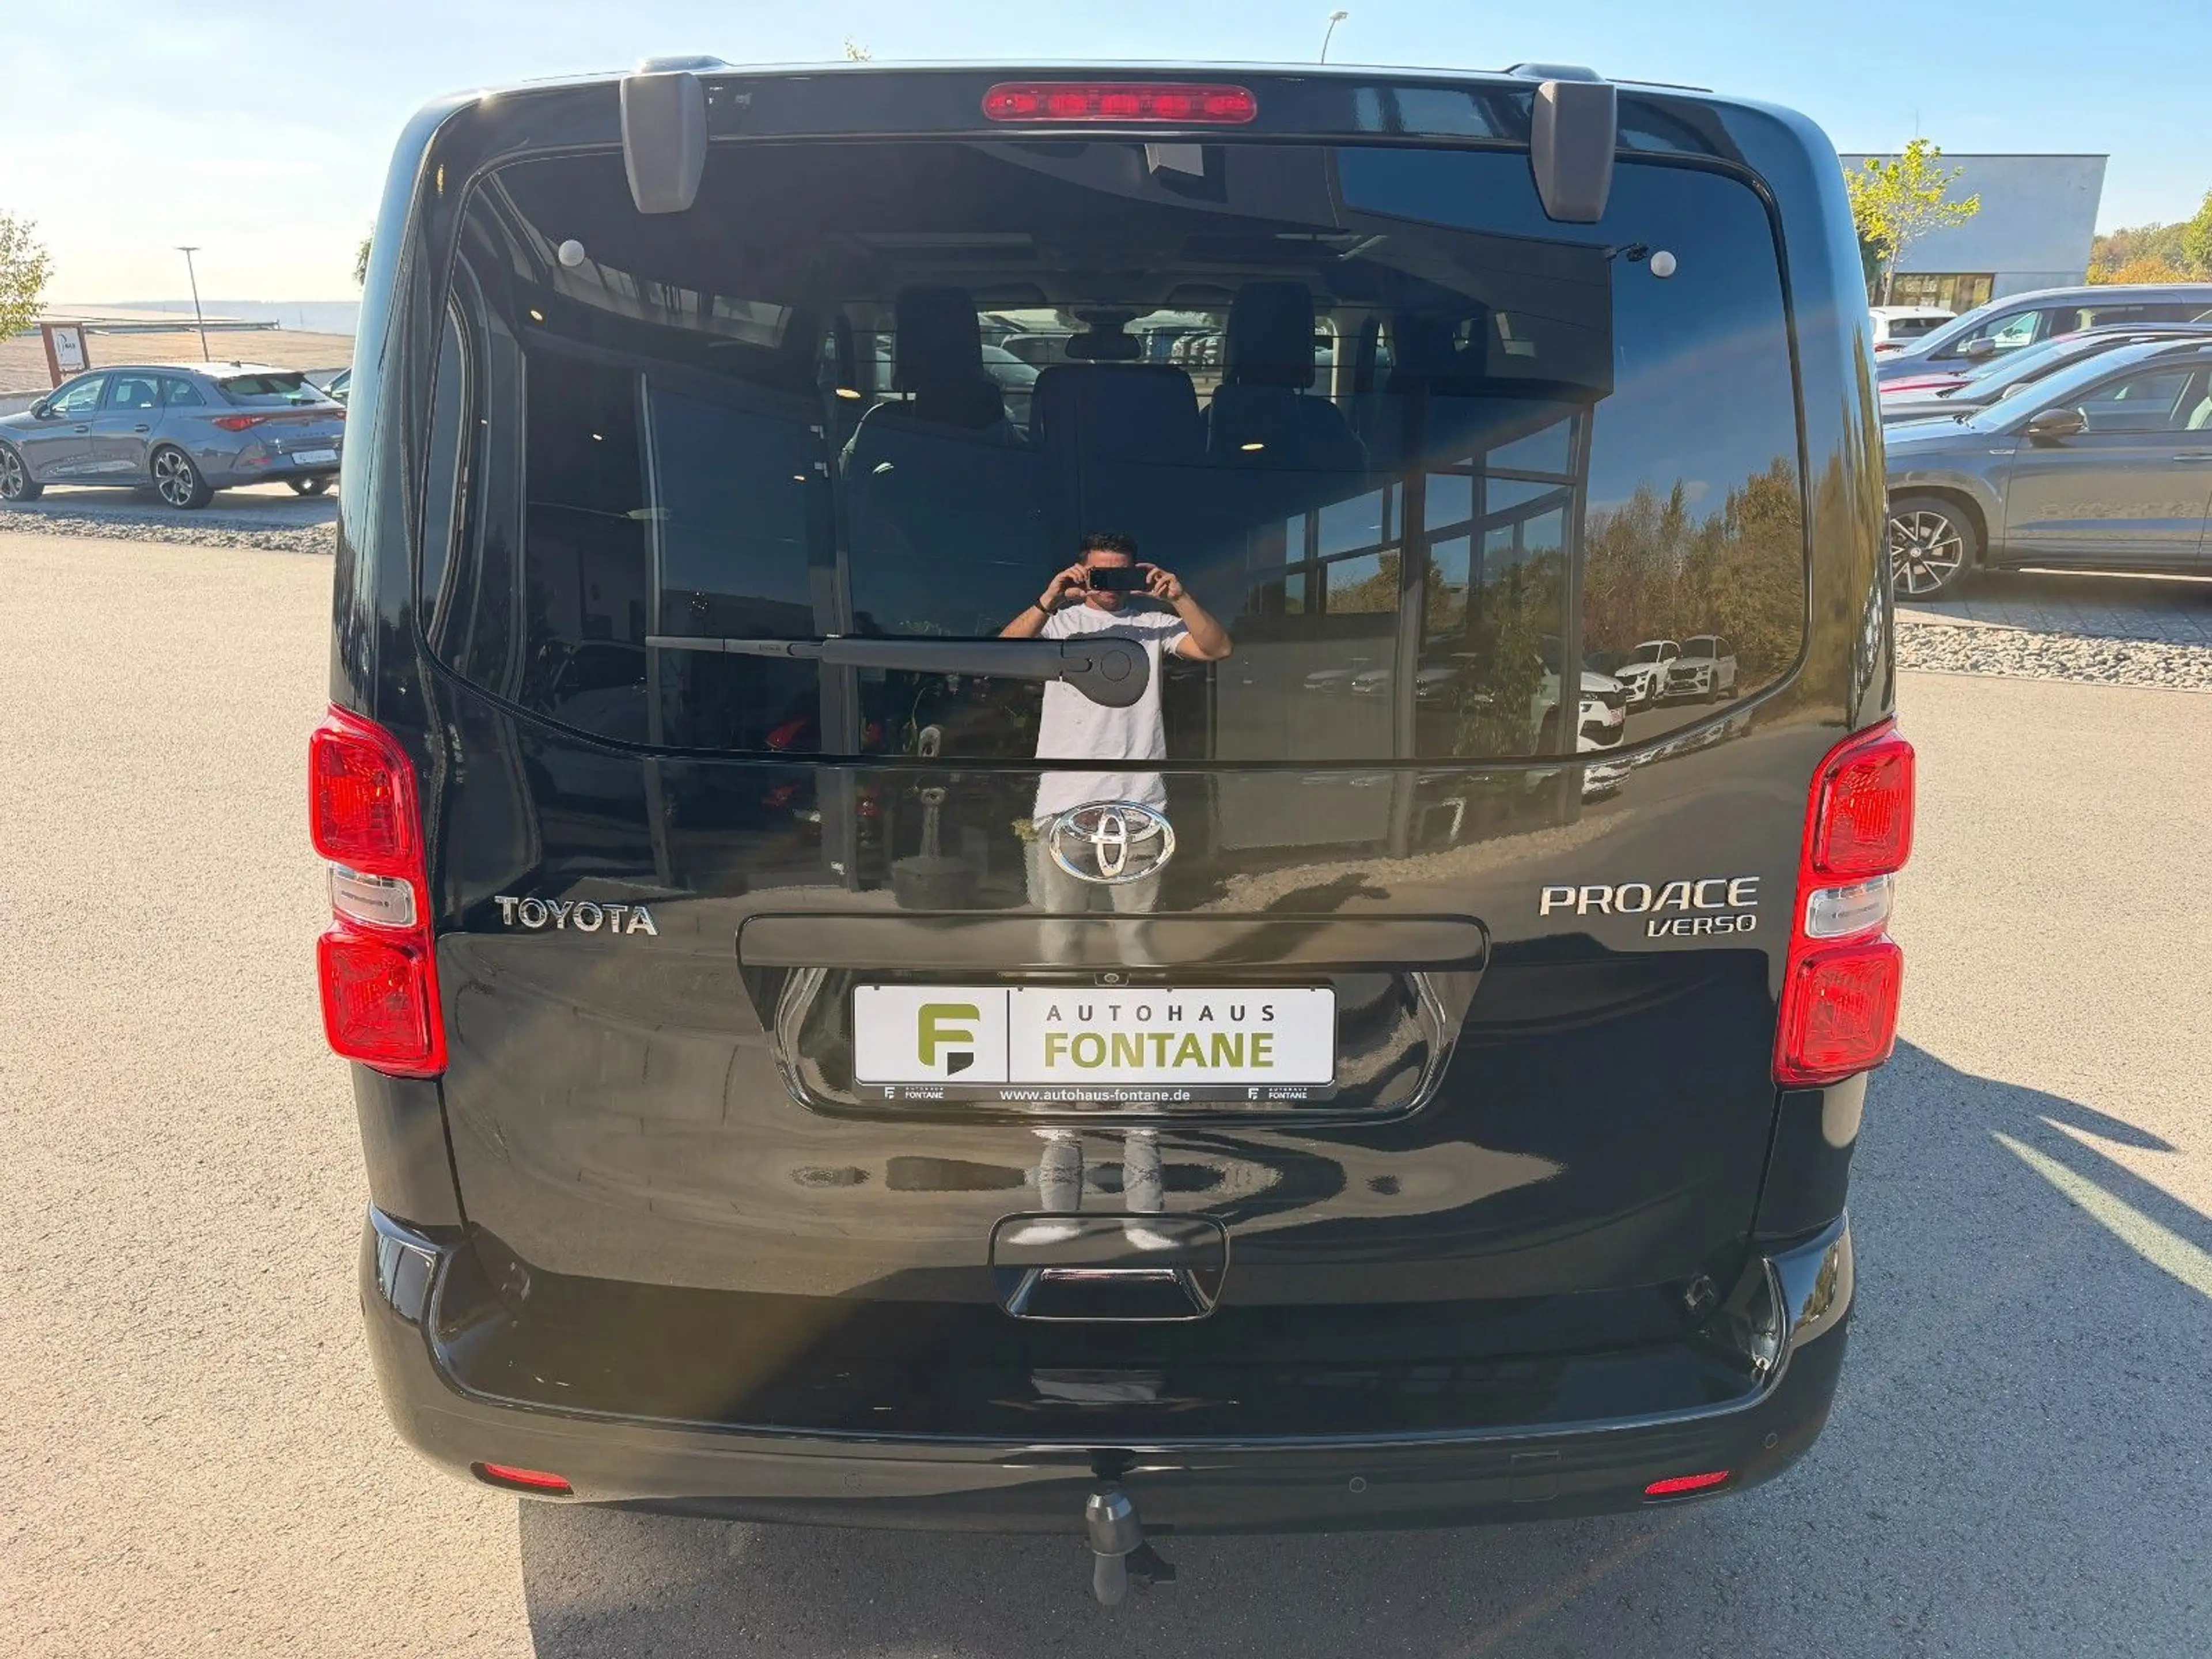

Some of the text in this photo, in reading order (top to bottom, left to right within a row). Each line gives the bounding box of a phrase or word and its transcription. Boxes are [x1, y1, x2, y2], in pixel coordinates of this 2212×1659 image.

[1539, 876, 1760, 916] PROACE
[494, 895, 658, 936] TOYOTA
[1647, 914, 1757, 937] VERSO
[1046, 1005, 1275, 1022] AUTOHAUS
[1044, 1032, 1274, 1068] FONTANE
[999, 1088, 1191, 1101] www.autohaus-fontane.de
